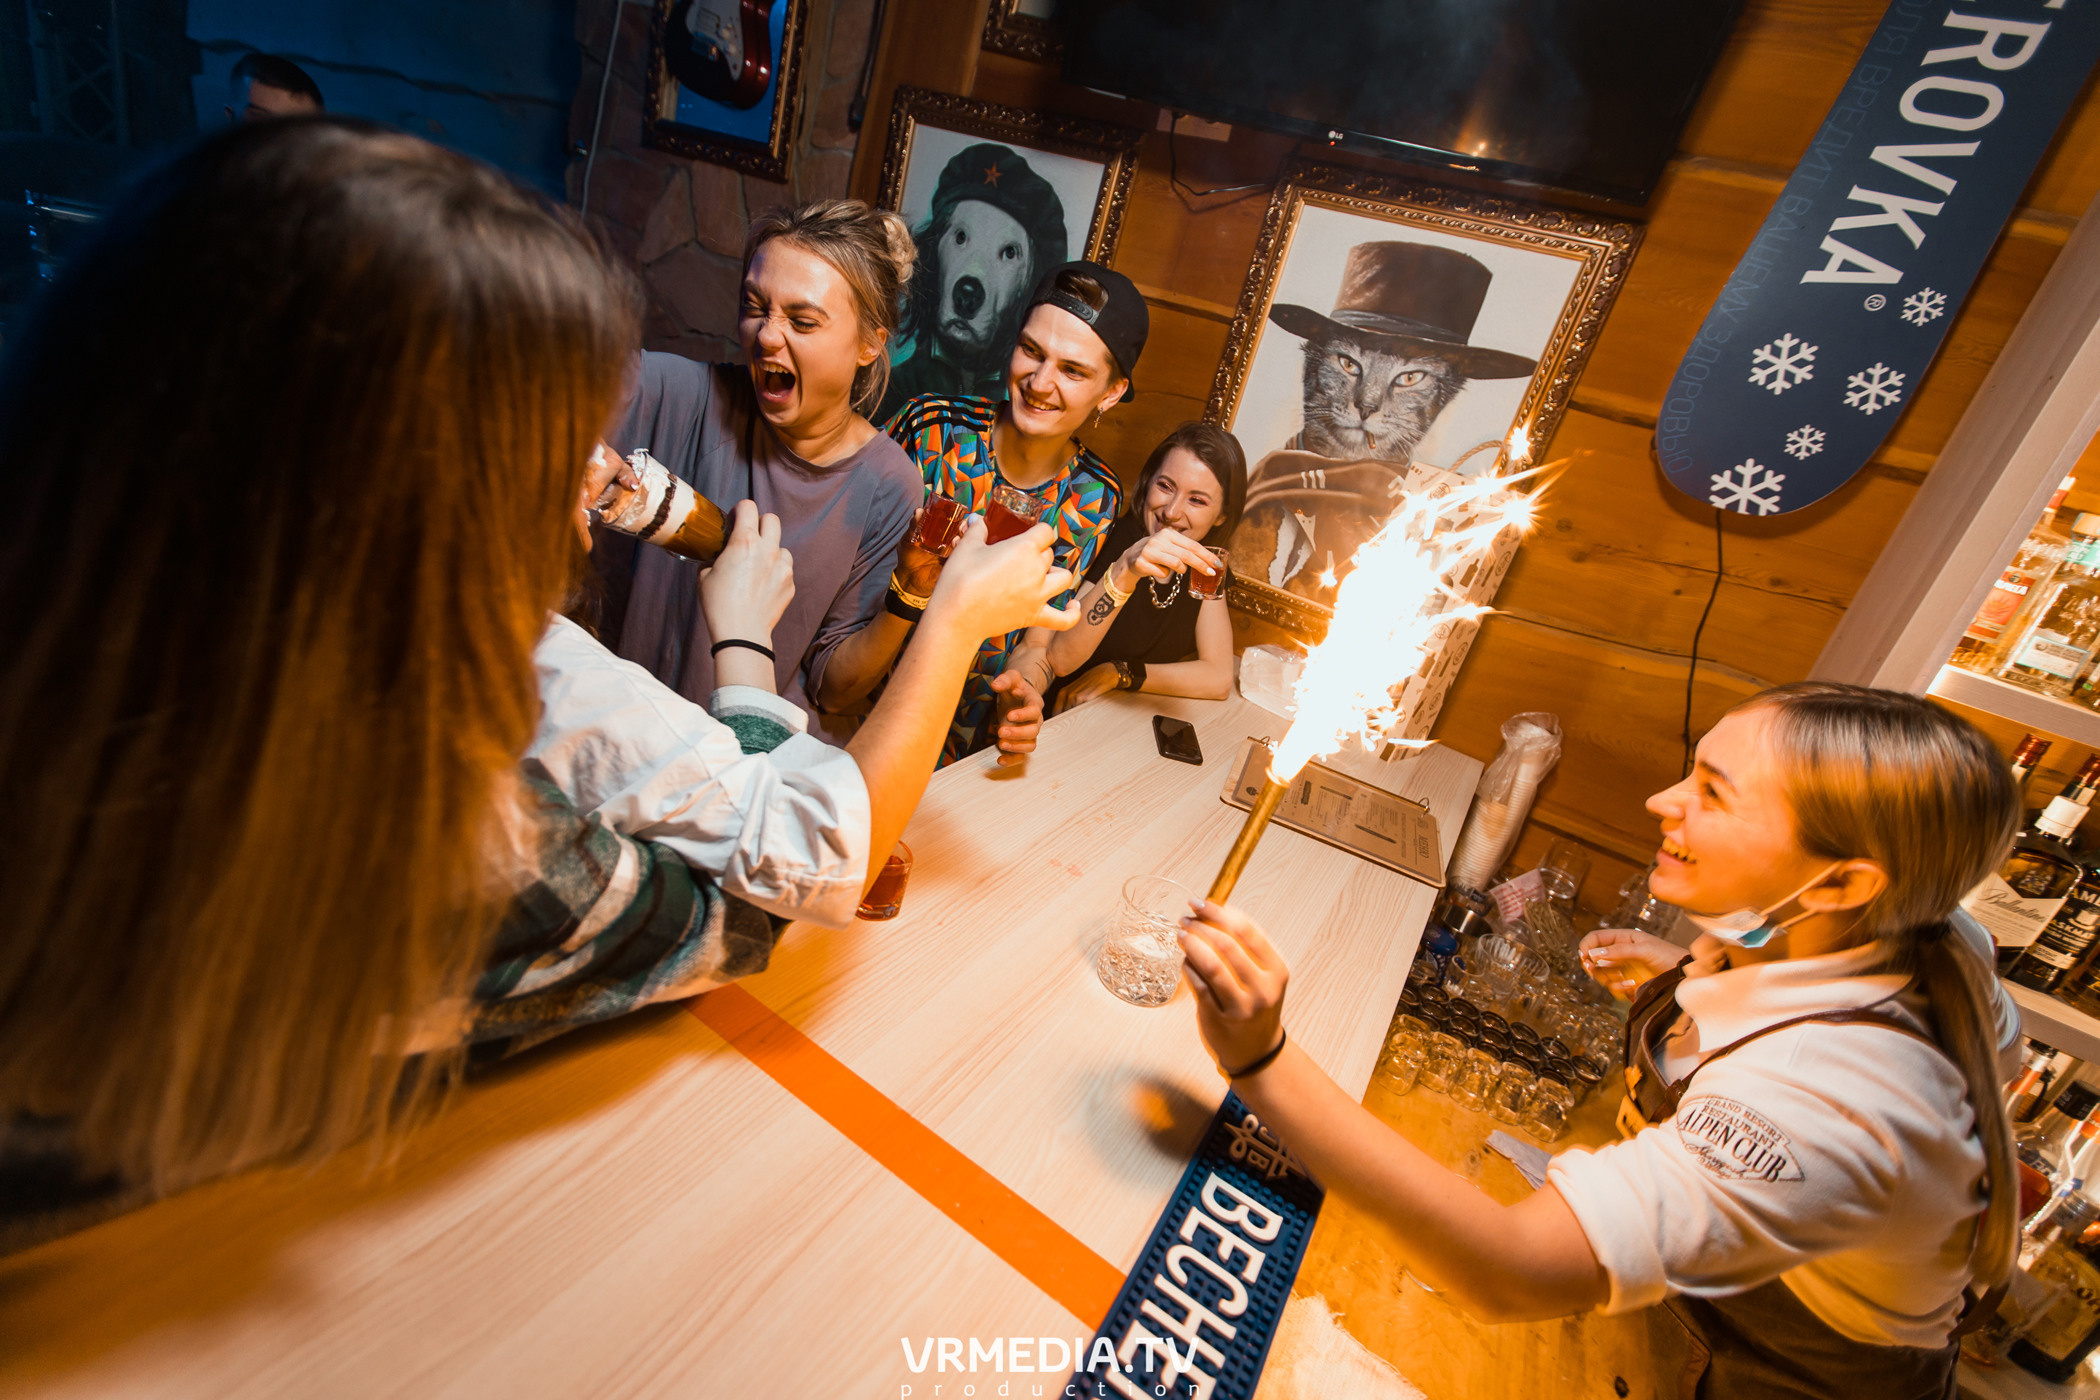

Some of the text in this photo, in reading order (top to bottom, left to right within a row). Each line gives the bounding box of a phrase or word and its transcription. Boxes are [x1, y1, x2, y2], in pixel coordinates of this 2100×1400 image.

[1799, 62, 1893, 190] ВРЕДИТ
[1799, 0, 2068, 285] ROVKA
[1718, 192, 1813, 324] ВАШЕМУ
[1662, 322, 1733, 475] ЗДОРОВЬЮ
[1676, 1106, 1788, 1184] ALPEN CLUB
[1700, 1104, 1778, 1150] RESTAURANT
[1706, 1098, 1786, 1143] GRAND RESORT
